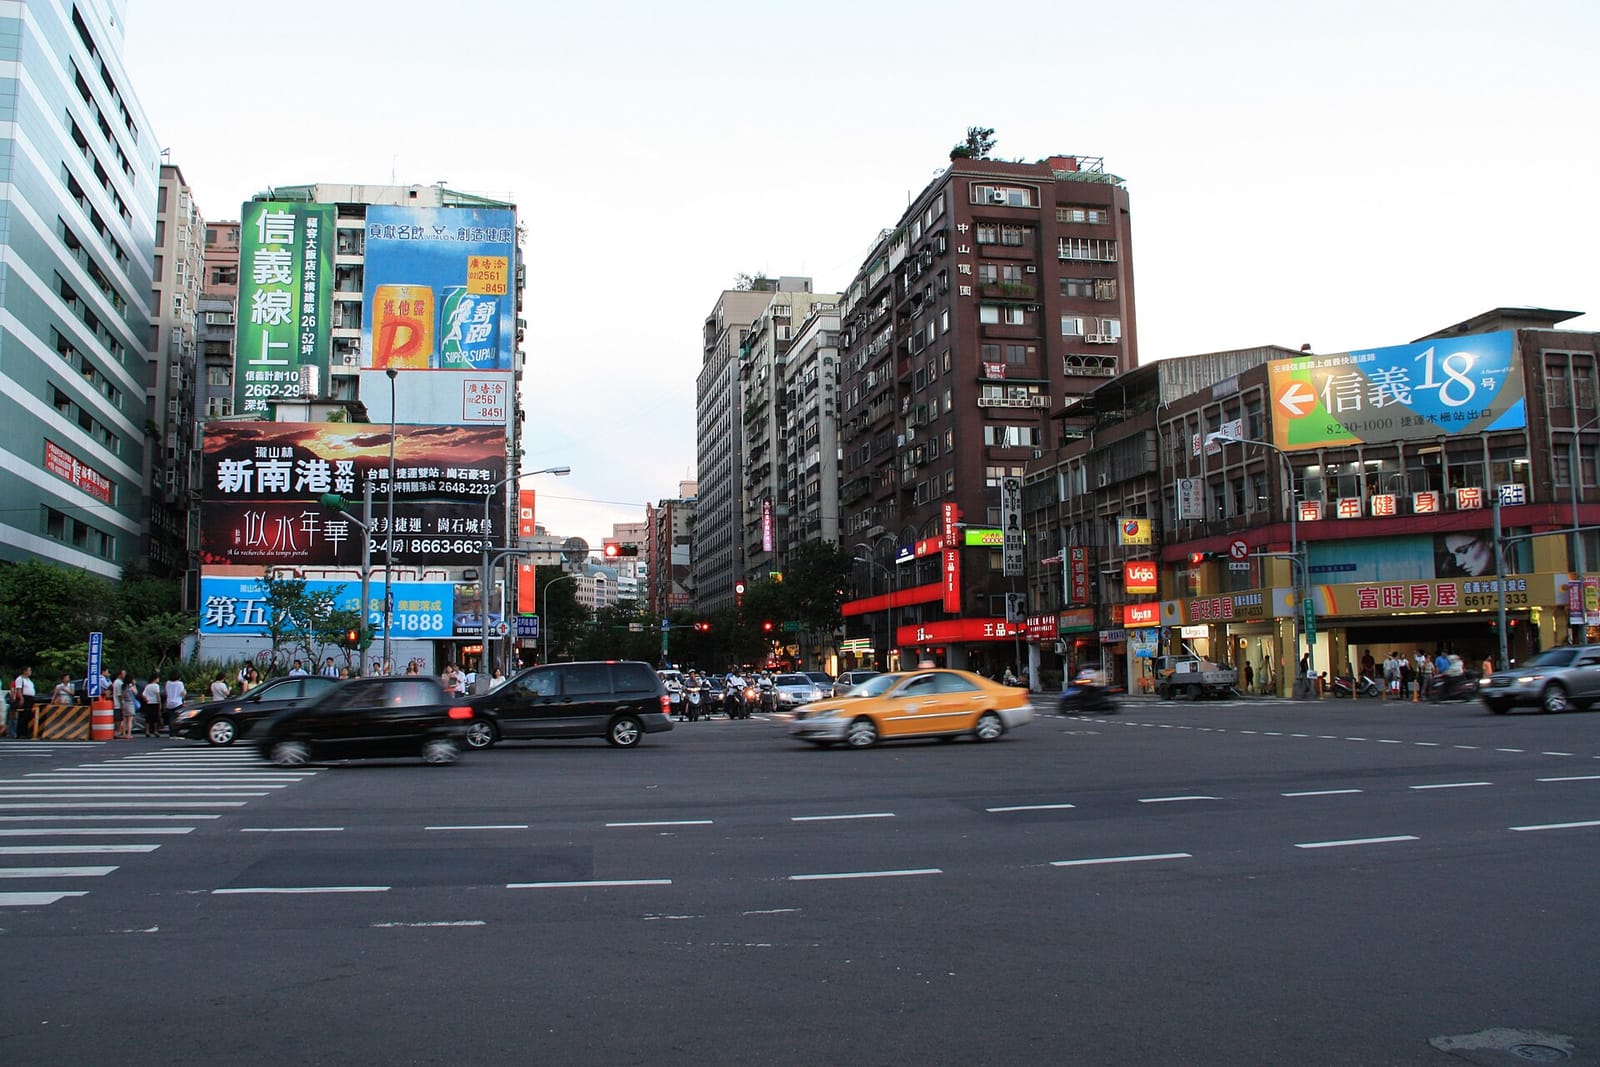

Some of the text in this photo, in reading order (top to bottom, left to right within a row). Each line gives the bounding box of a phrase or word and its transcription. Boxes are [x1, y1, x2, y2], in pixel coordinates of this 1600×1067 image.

[369, 224, 424, 240] 貢獻名飲
[457, 227, 512, 243] 創造健康
[249, 208, 296, 366] 信義線上
[383, 299, 425, 316] 維他露
[464, 301, 497, 345] 舒跑
[445, 350, 471, 363] SUPER
[1321, 366, 1413, 414] 信義
[1414, 346, 1476, 407] 18
[244, 399, 269, 411] 深坑
[1326, 408, 1492, 435] 8230-1000 捷運木柵站出口
[217, 459, 331, 493] 新南港
[1500, 485, 1523, 505] 招生
[243, 509, 349, 557] 似水年華
[1357, 582, 1458, 611] 富旺房屋
[1464, 593, 1529, 607] 6617-333
[983, 623, 1006, 637] 王品
